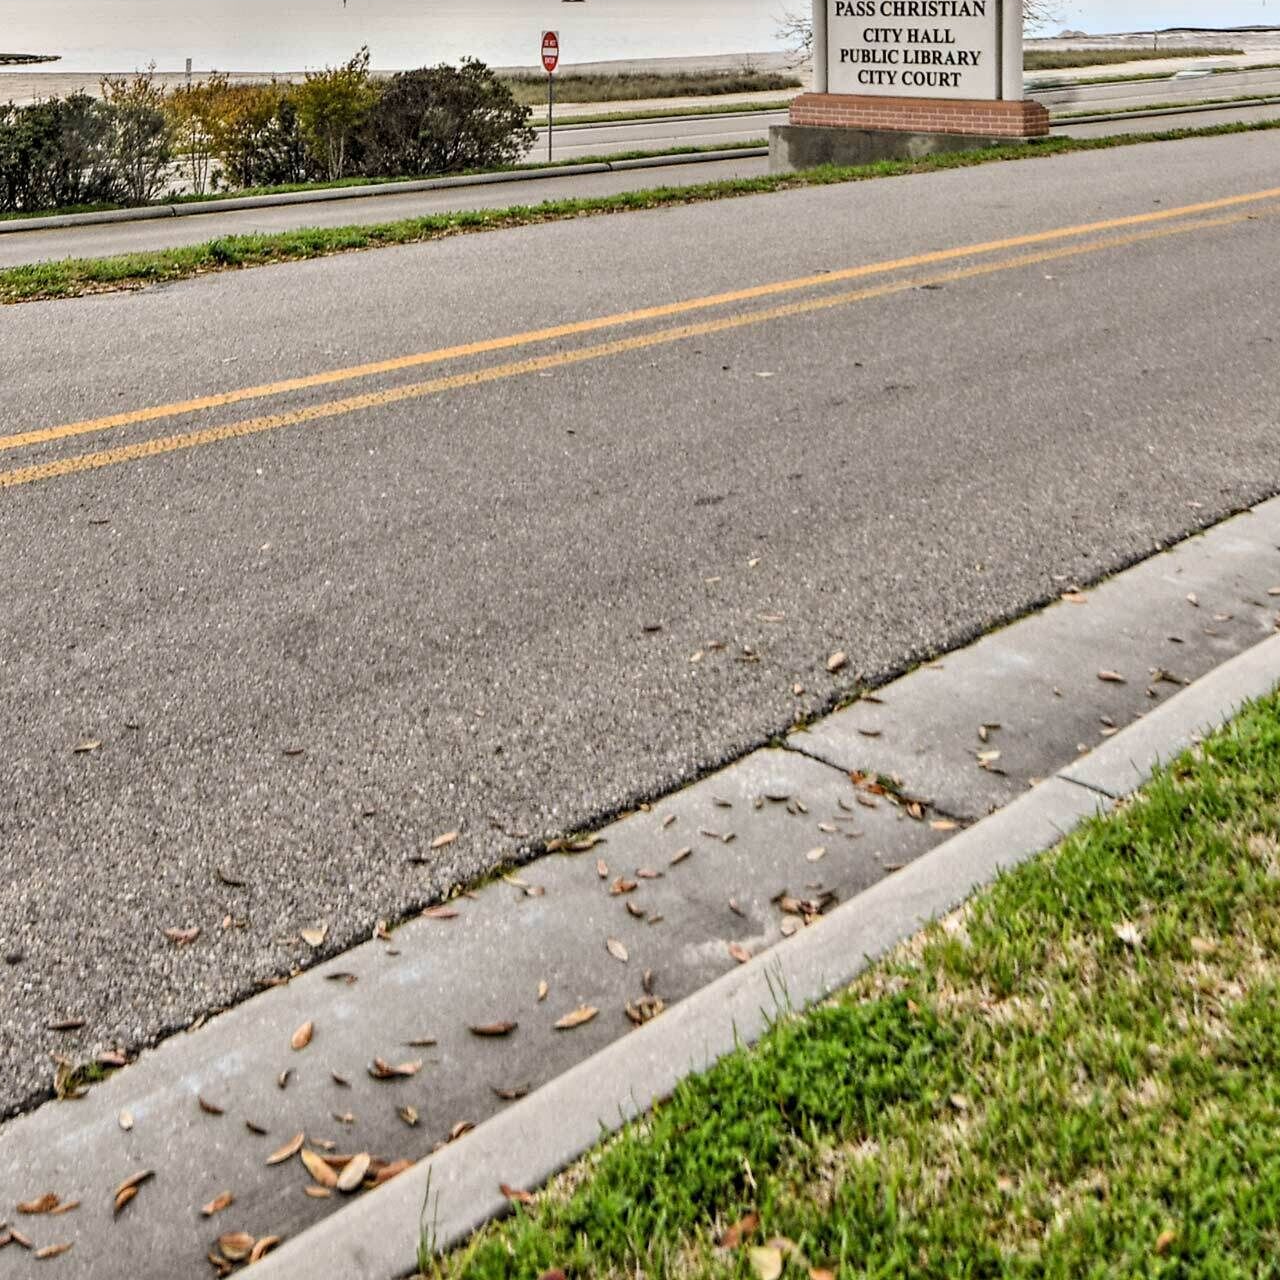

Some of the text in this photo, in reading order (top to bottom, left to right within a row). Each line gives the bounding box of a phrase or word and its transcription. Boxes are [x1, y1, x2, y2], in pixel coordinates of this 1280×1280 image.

[835, 0, 986, 17] PASS CHRISTIAN
[863, 28, 955, 44] CITY HALL
[840, 48, 981, 66] PUBLIC LIBRARY
[858, 69, 962, 87] CITY COURT
